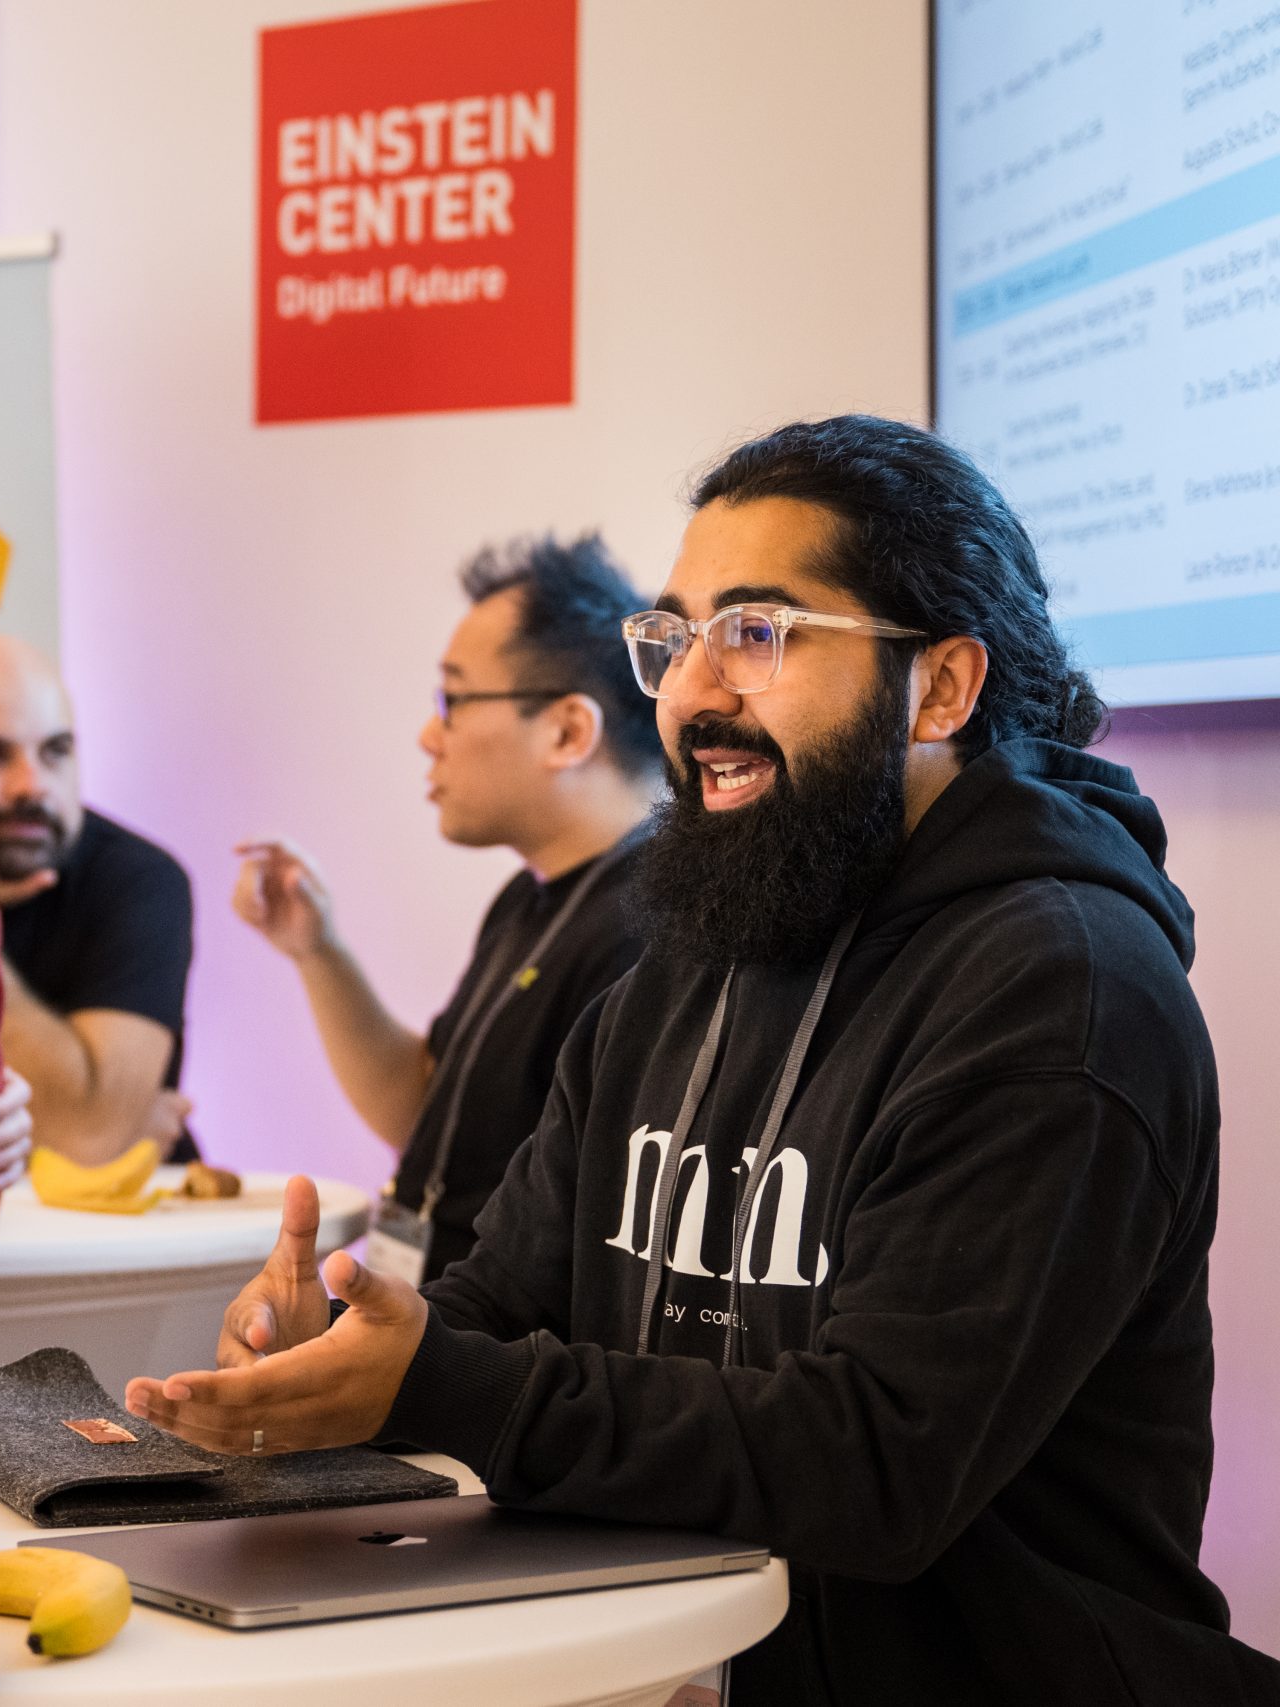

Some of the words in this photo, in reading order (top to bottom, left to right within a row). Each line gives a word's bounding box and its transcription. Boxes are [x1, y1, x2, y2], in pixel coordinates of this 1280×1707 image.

[278, 89, 555, 187] EINSTEIN
[277, 169, 514, 257] CENTER
[277, 270, 384, 324] Digital
[389, 265, 506, 308] Future
